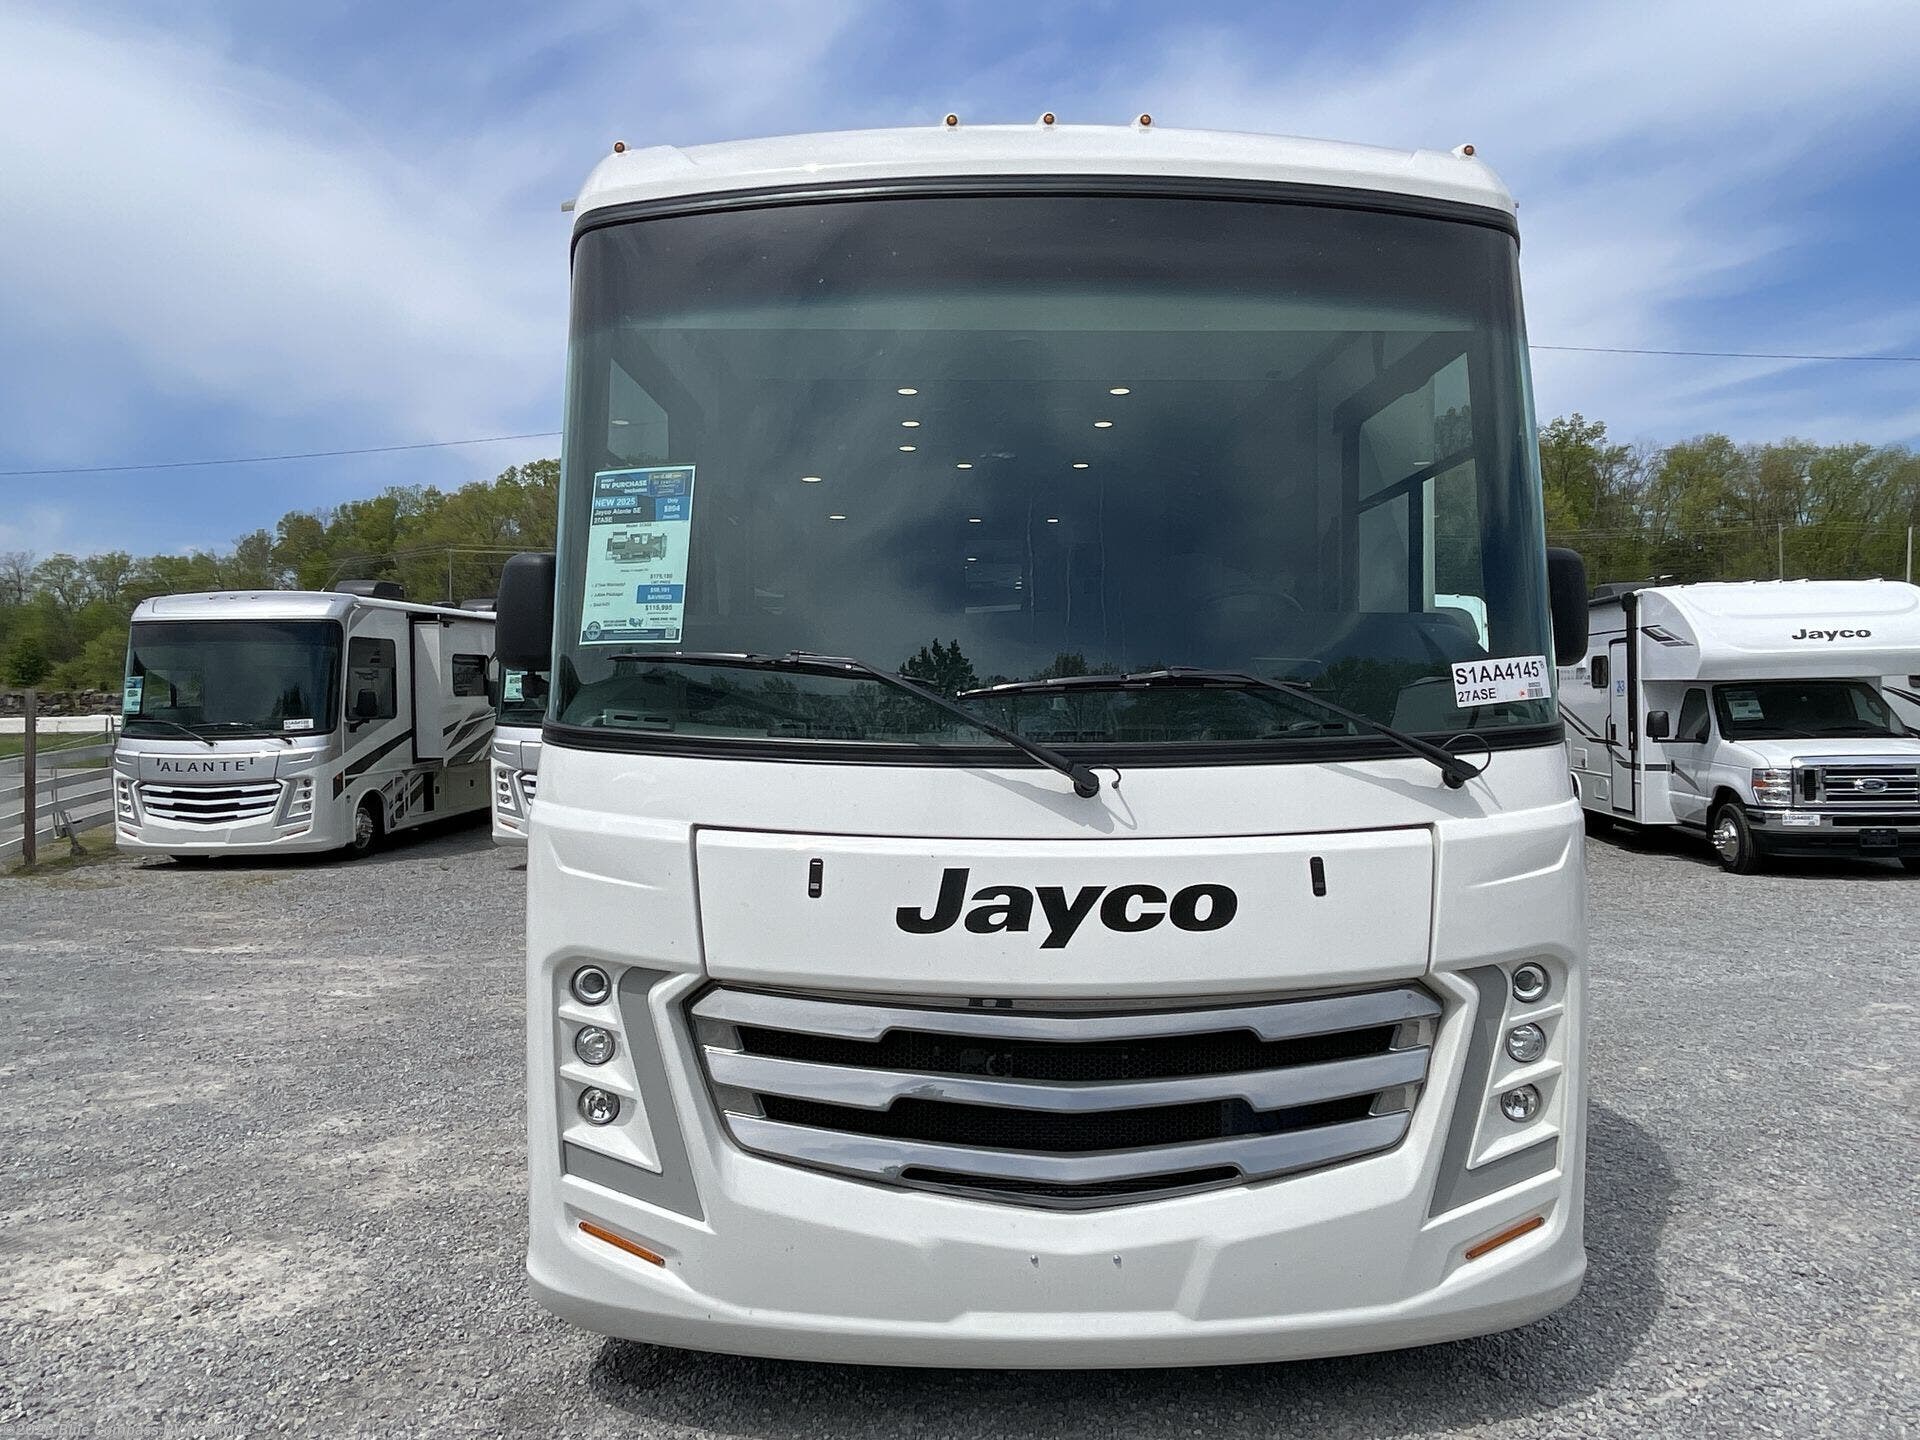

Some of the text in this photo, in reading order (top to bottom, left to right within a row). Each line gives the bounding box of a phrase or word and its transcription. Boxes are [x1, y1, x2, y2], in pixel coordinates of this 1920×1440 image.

[612, 480, 648, 489] PURCHASE
[595, 497, 636, 507] NEW 2025
[594, 509, 612, 517] Jayco
[1791, 628, 1872, 641] Jayco
[1455, 660, 1540, 685] S1AA4145
[1457, 687, 1497, 703] 27ASE
[160, 760, 246, 772] ALANTE
[895, 867, 1238, 949] Jayco
